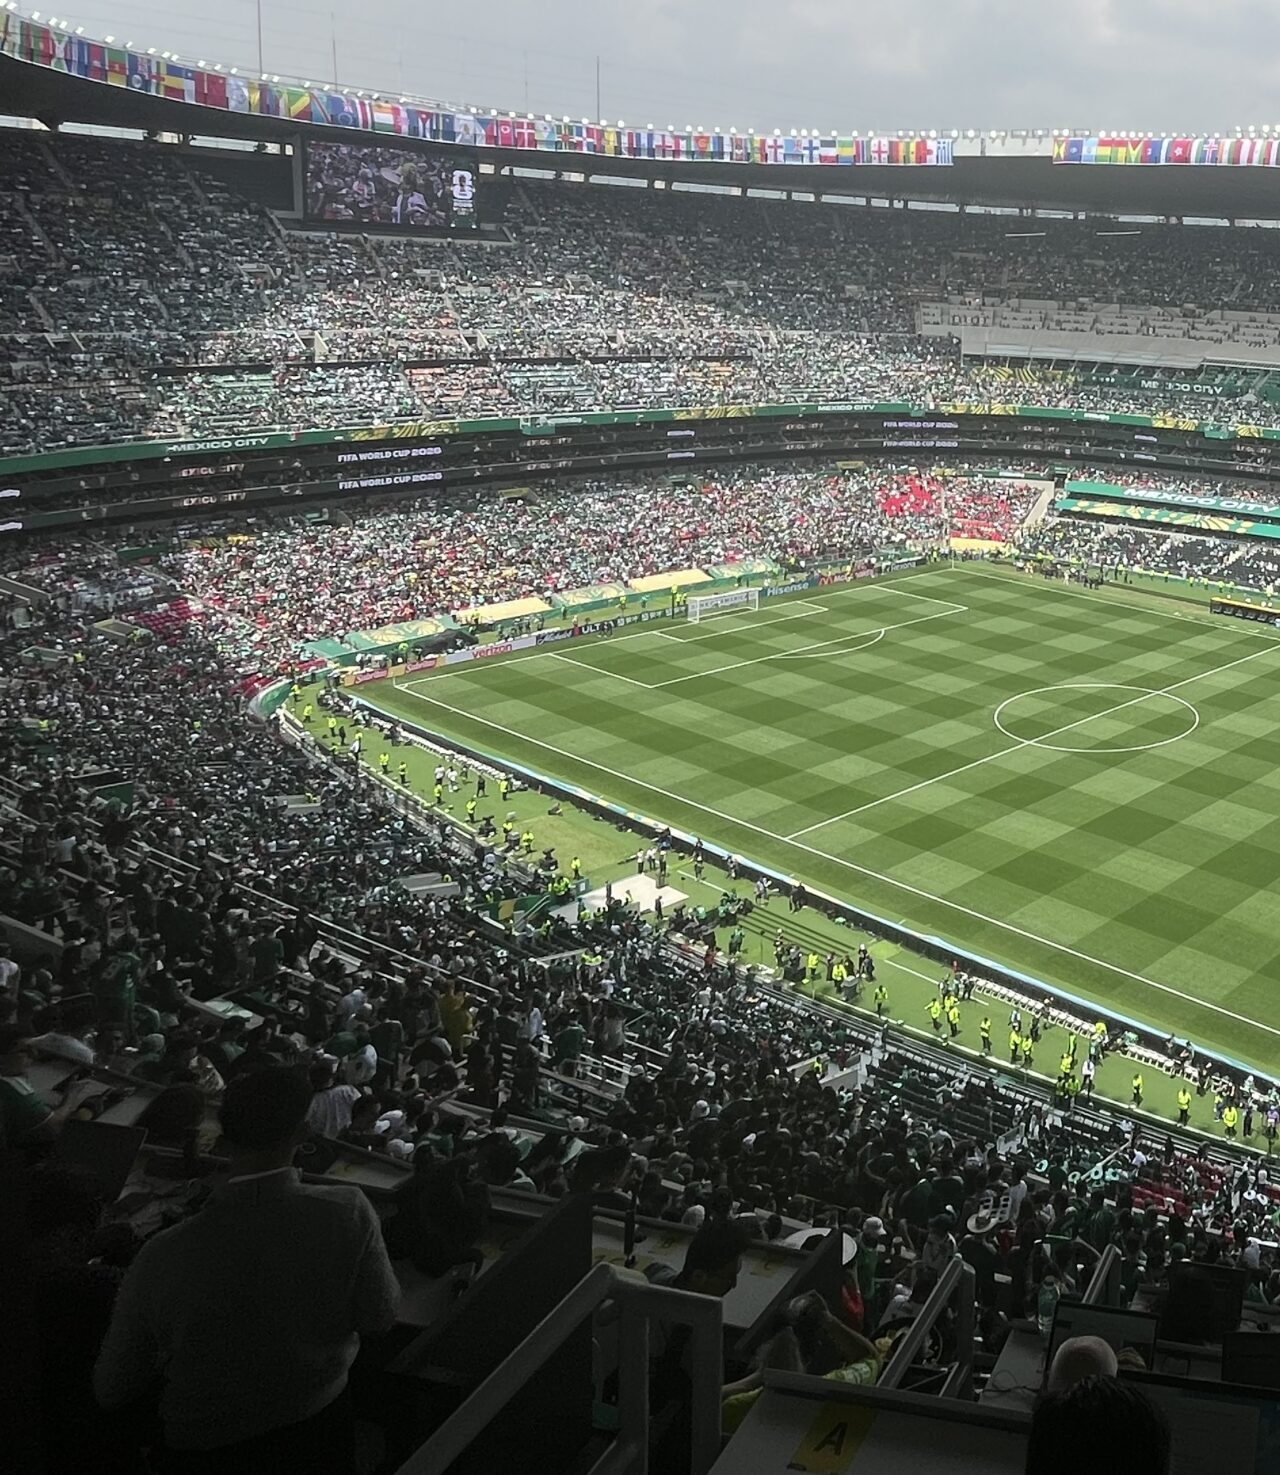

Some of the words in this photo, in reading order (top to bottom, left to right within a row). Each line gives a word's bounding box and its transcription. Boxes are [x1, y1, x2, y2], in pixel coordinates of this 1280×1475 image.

[173, 440, 232, 452] MEXICO
[235, 437, 269, 448] CITY
[337, 454, 358, 462] FIFA
[359, 451, 392, 460] WORLD
[392, 449, 411, 457] CUP
[171, 466, 215, 477] EXICO
[338, 481, 359, 489] FIFA
[359, 478, 392, 487] WORLD
[393, 476, 411, 484] CUP
[173, 496, 216, 507] EXICO
[1123, 488, 1217, 506] MEXICO
[1219, 501, 1280, 513] CITY
[766, 581, 809, 597] Hisense
[471, 643, 513, 659] verizon
[813, 1421, 848, 1456] A
